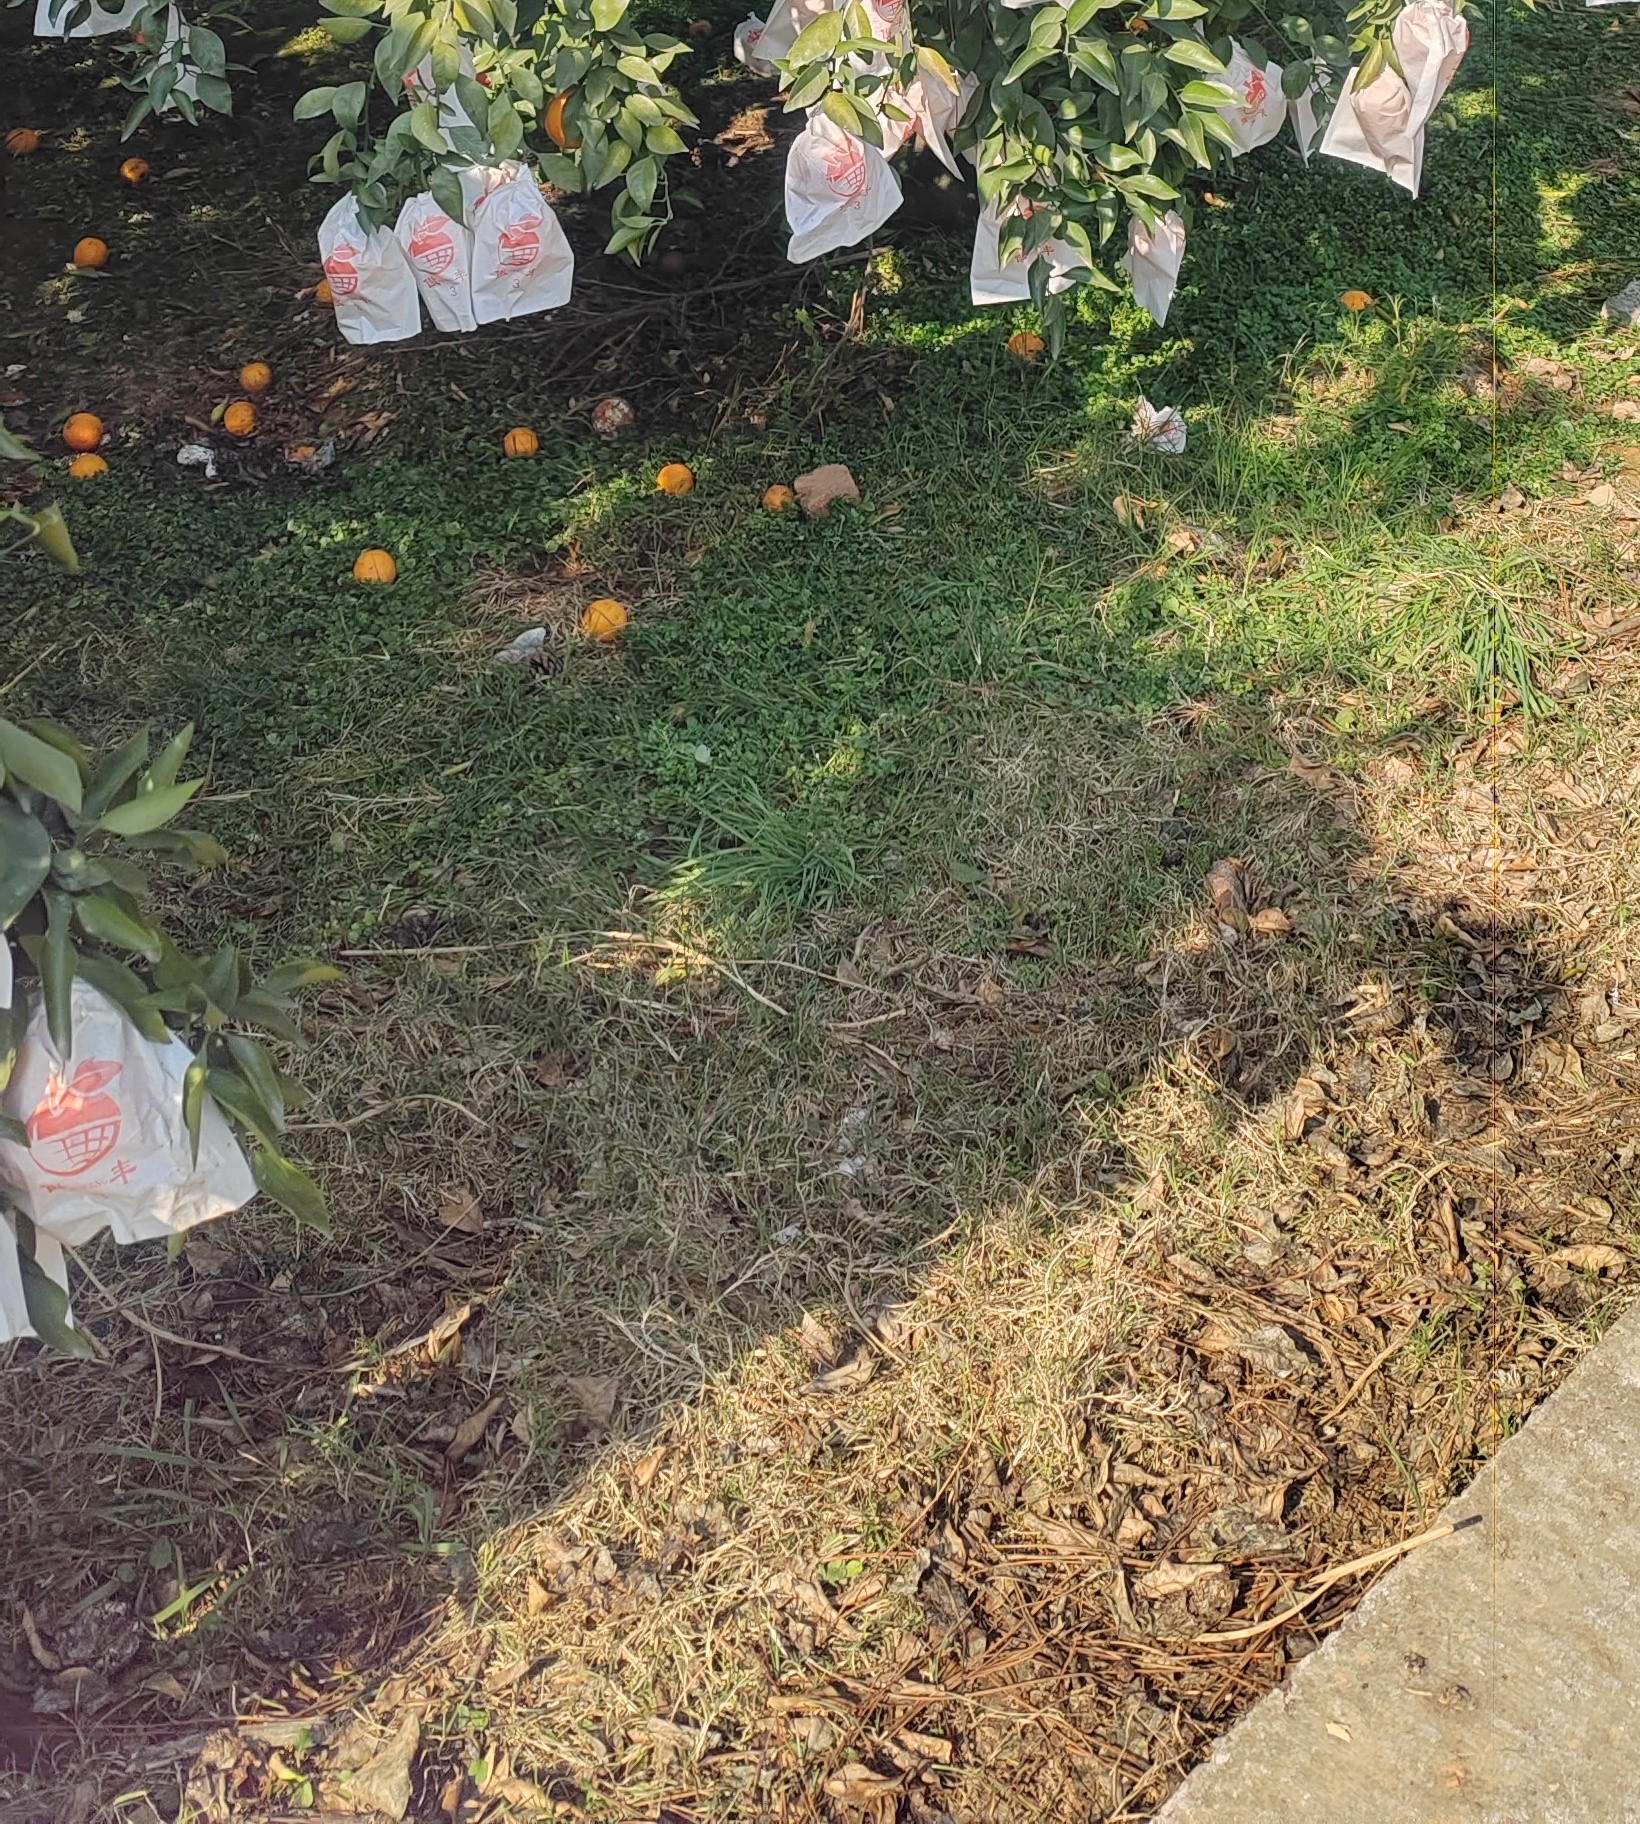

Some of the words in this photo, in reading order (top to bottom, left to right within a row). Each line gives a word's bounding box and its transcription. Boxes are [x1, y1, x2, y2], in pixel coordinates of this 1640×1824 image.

[853, 200, 861, 211] 3
[511, 278, 519, 289] 3
[449, 285, 457, 297] 3
[110, 1159, 138, 1185] 丰
